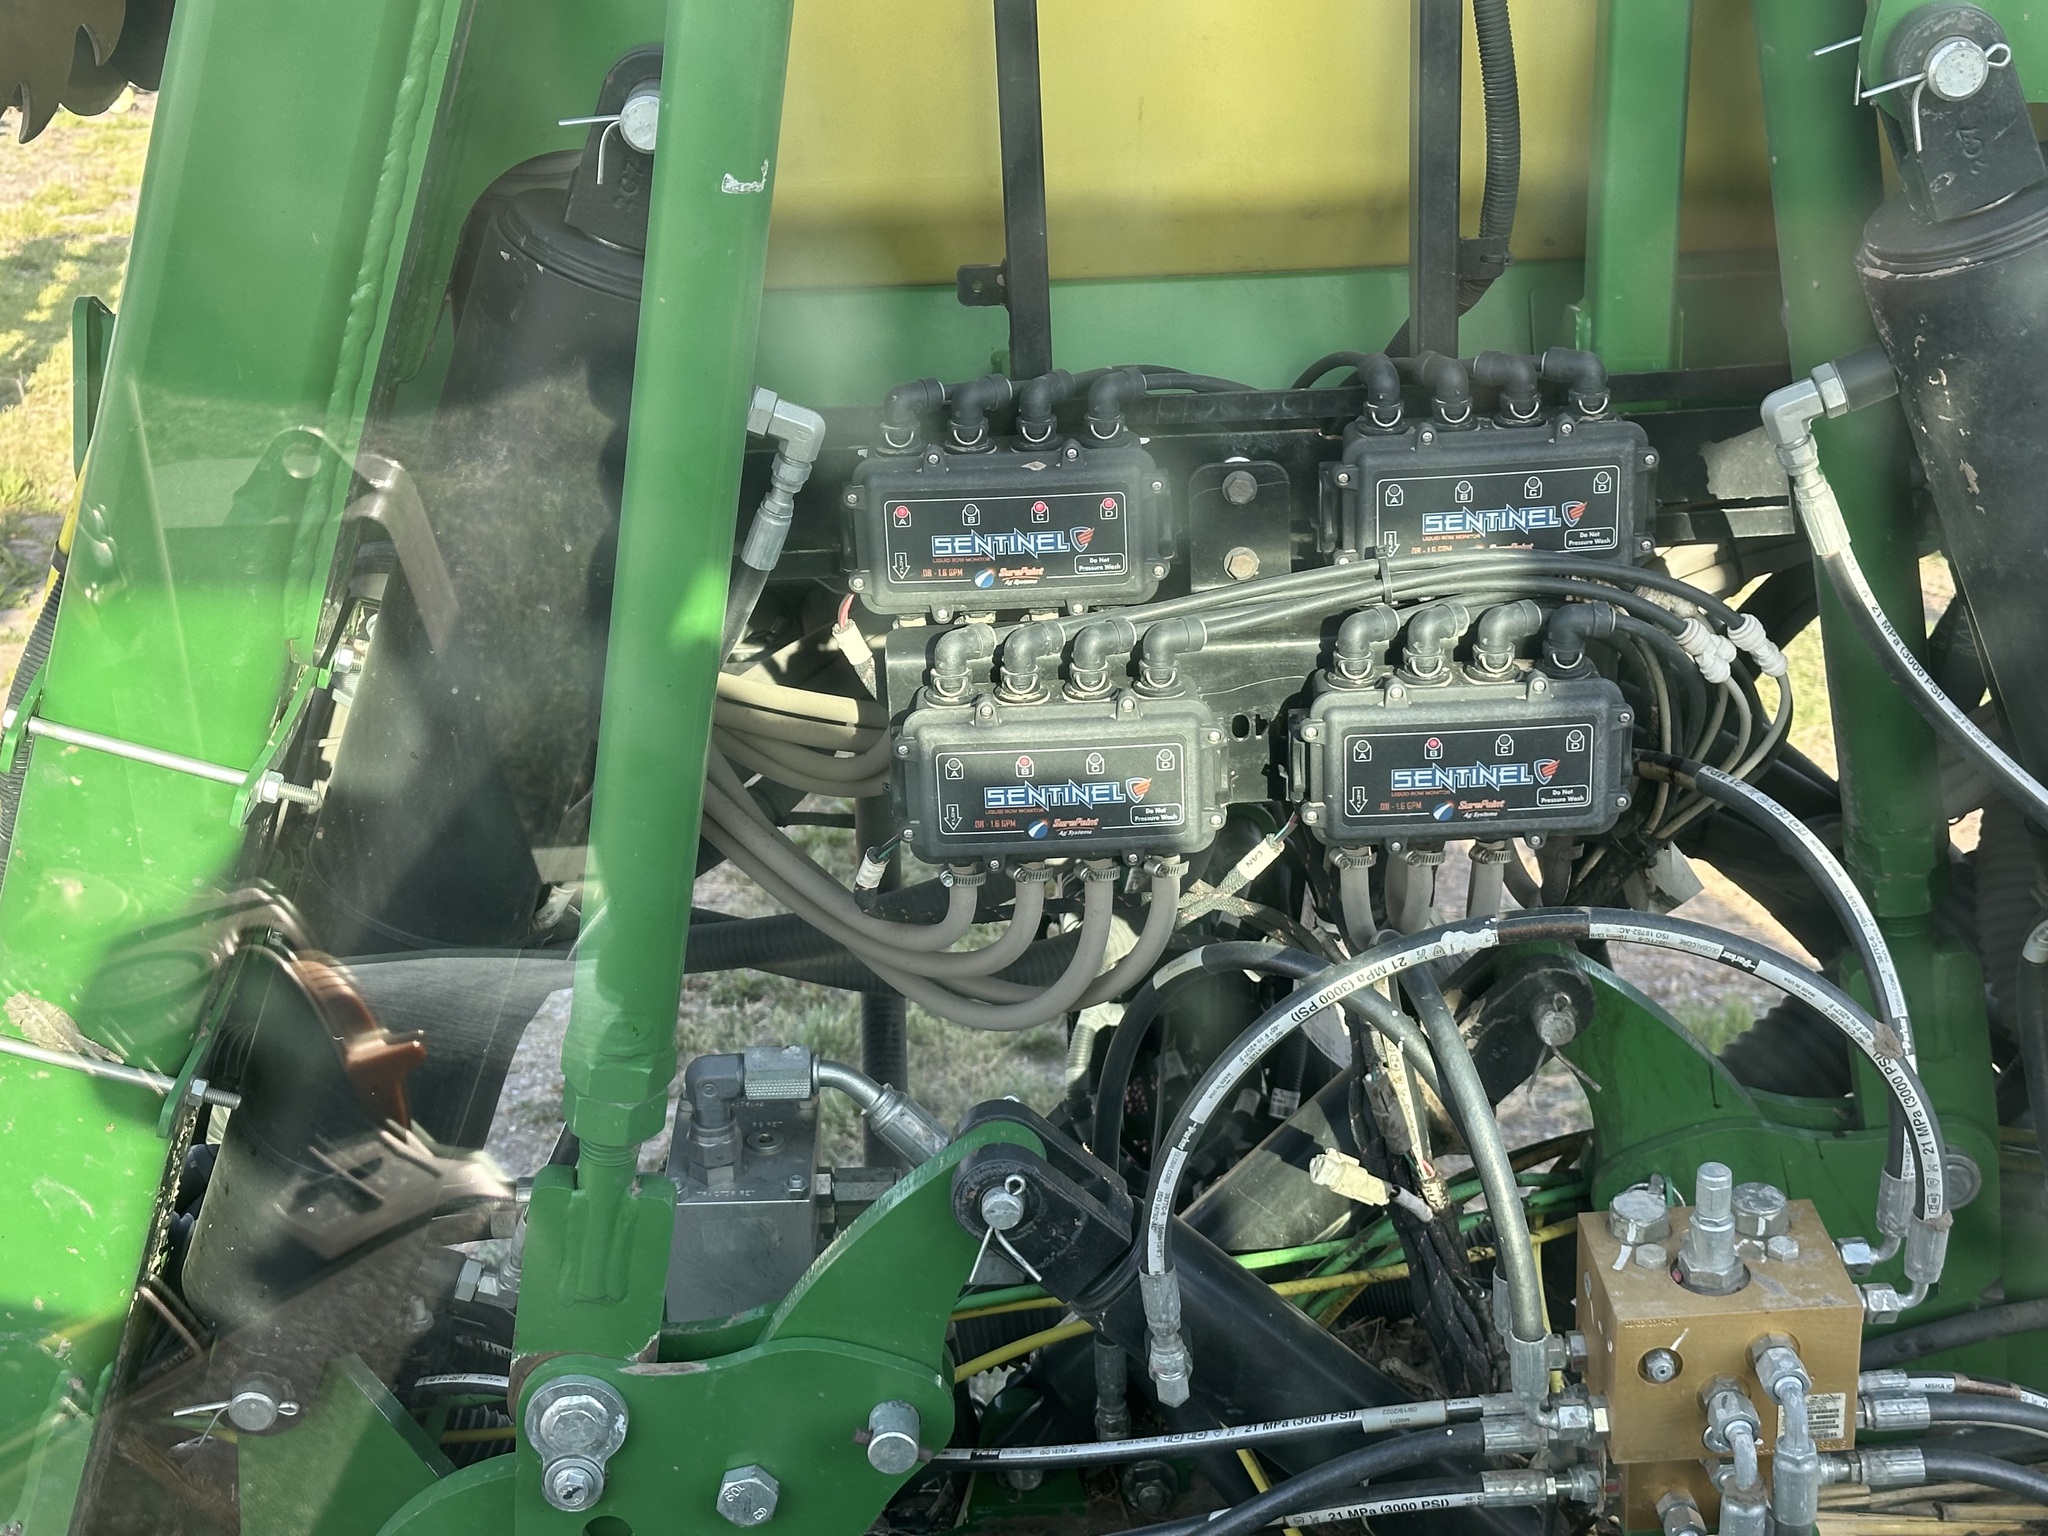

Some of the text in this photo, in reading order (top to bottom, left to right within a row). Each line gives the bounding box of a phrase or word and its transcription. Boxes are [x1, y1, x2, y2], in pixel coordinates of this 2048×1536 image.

[1390, 496, 1399, 504] A
[1423, 506, 1561, 534] SENTINEL
[932, 530, 1070, 558] SENTINEL
[949, 568, 963, 576] GPM
[1871, 604, 1945, 701] 21 MPa (3000 PSI)
[1501, 746, 1509, 754] C
[1571, 742, 1580, 750] D
[1391, 763, 1533, 790] SENTINEL
[984, 781, 1126, 808] SENTINEL
[1407, 802, 1422, 810] GPM
[1619, 927, 1655, 937] 18752-AC
[1679, 939, 1720, 955] GLOBALCORE
[1721, 951, 1755, 968] Parker
[1290, 956, 1407, 1022] 21 MPa (3000 PSI)
[1892, 1075, 1918, 1108] (3000
[1912, 1110, 1929, 1137] MPa
[1178, 1123, 1197, 1150] Parker
[1921, 1141, 1935, 1155] 21
[1244, 1410, 1357, 1433] 21 MPa (3000 PSI)
[1328, 1498, 1450, 1521] 21 MPa (3000 PSI)
